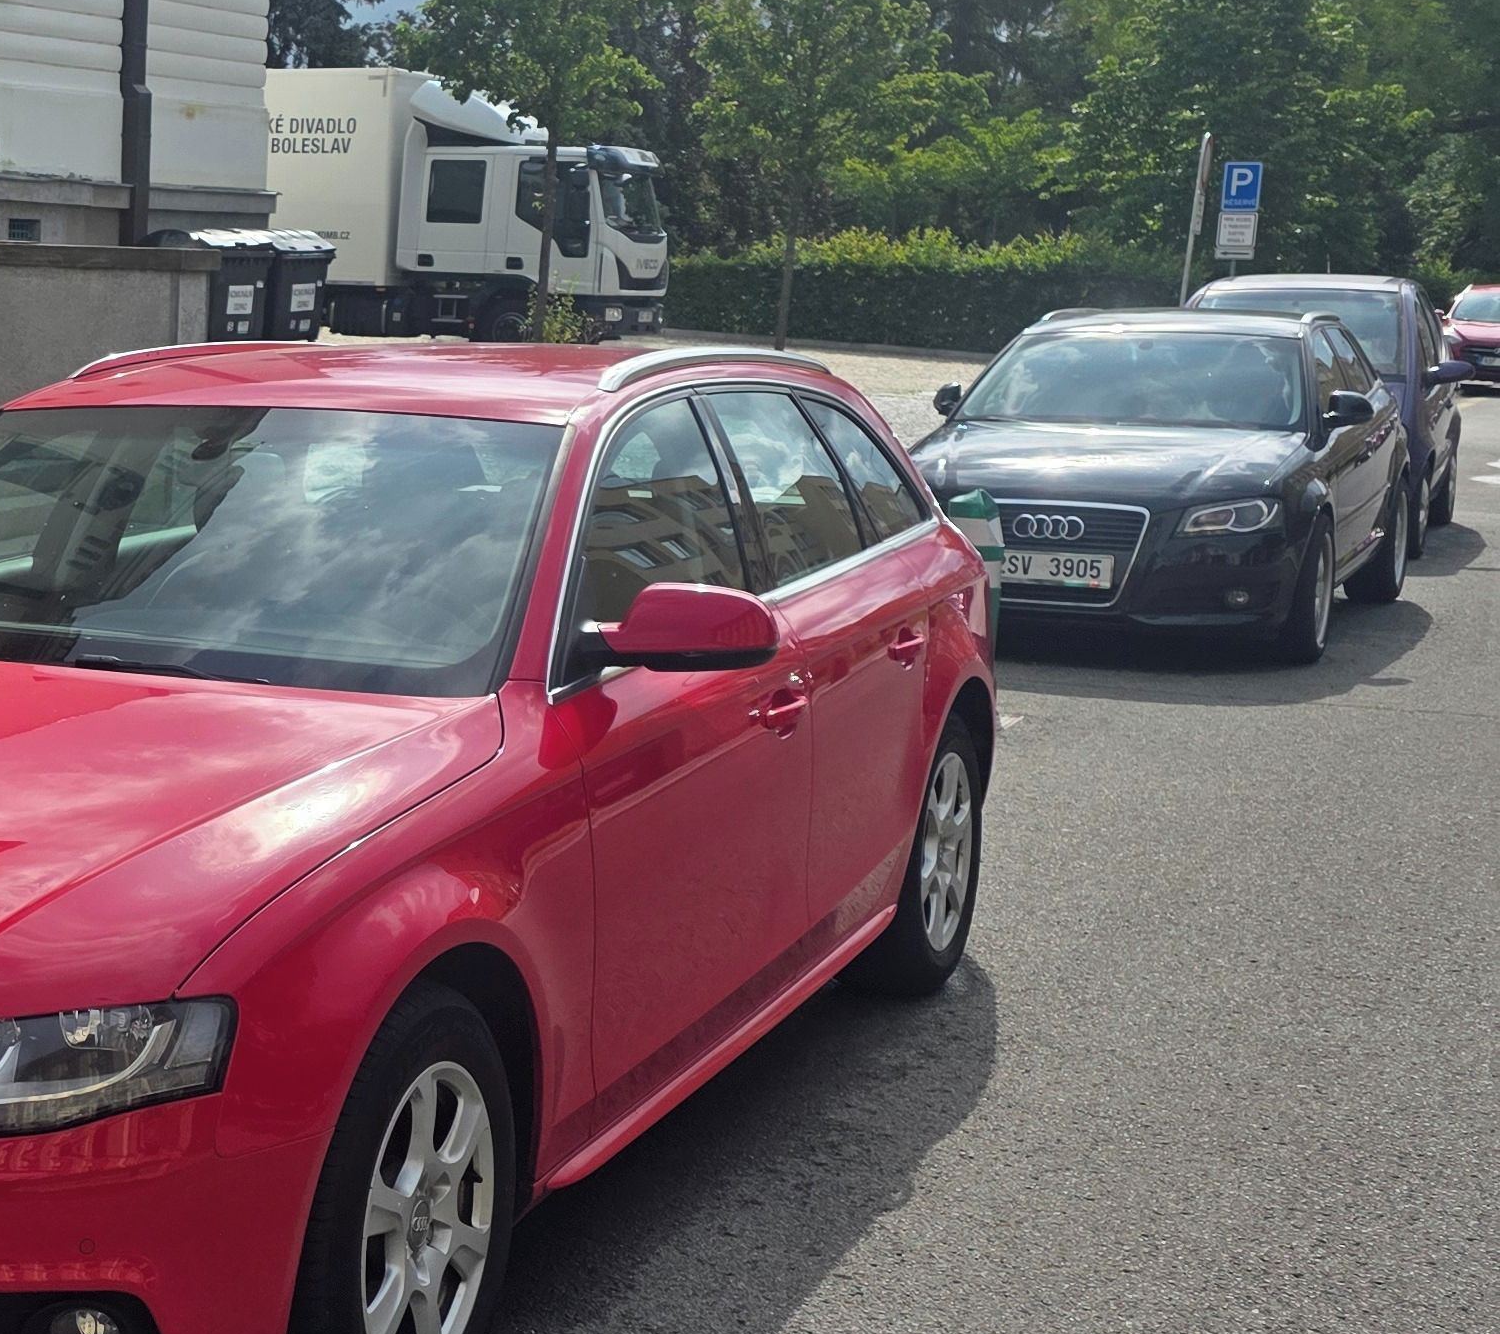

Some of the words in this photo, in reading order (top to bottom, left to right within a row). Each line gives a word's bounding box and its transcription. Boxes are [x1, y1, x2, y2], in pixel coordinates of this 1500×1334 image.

[289, 117, 357, 134] DIVADLO
[271, 137, 351, 154] BOLESLAV
[1231, 168, 1253, 196] P
[1049, 557, 1102, 578] 3905
